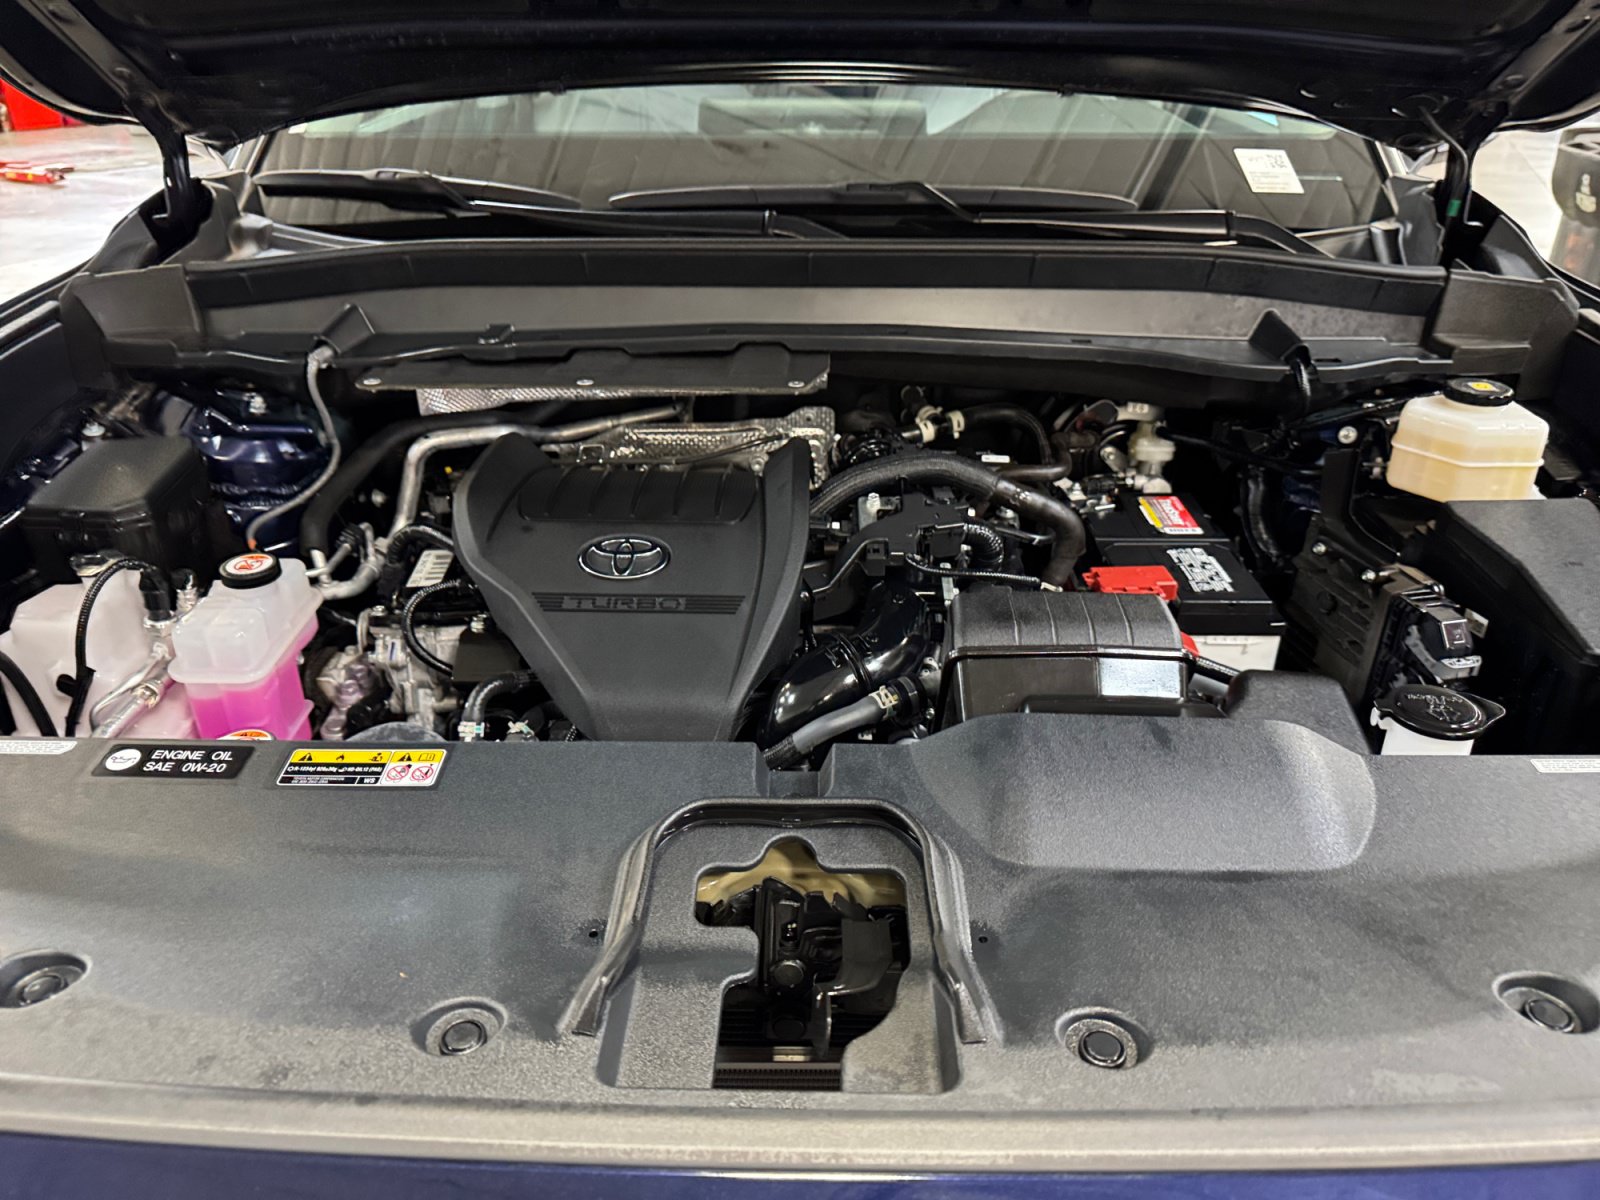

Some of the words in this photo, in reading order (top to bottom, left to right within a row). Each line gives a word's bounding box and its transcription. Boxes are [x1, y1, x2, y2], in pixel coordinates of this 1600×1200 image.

[573, 597, 682, 610] TURBO
[151, 749, 205, 760] ENGINE
[211, 750, 233, 761] OIL
[143, 761, 175, 772] SAE
[182, 762, 227, 773] 0W-20
